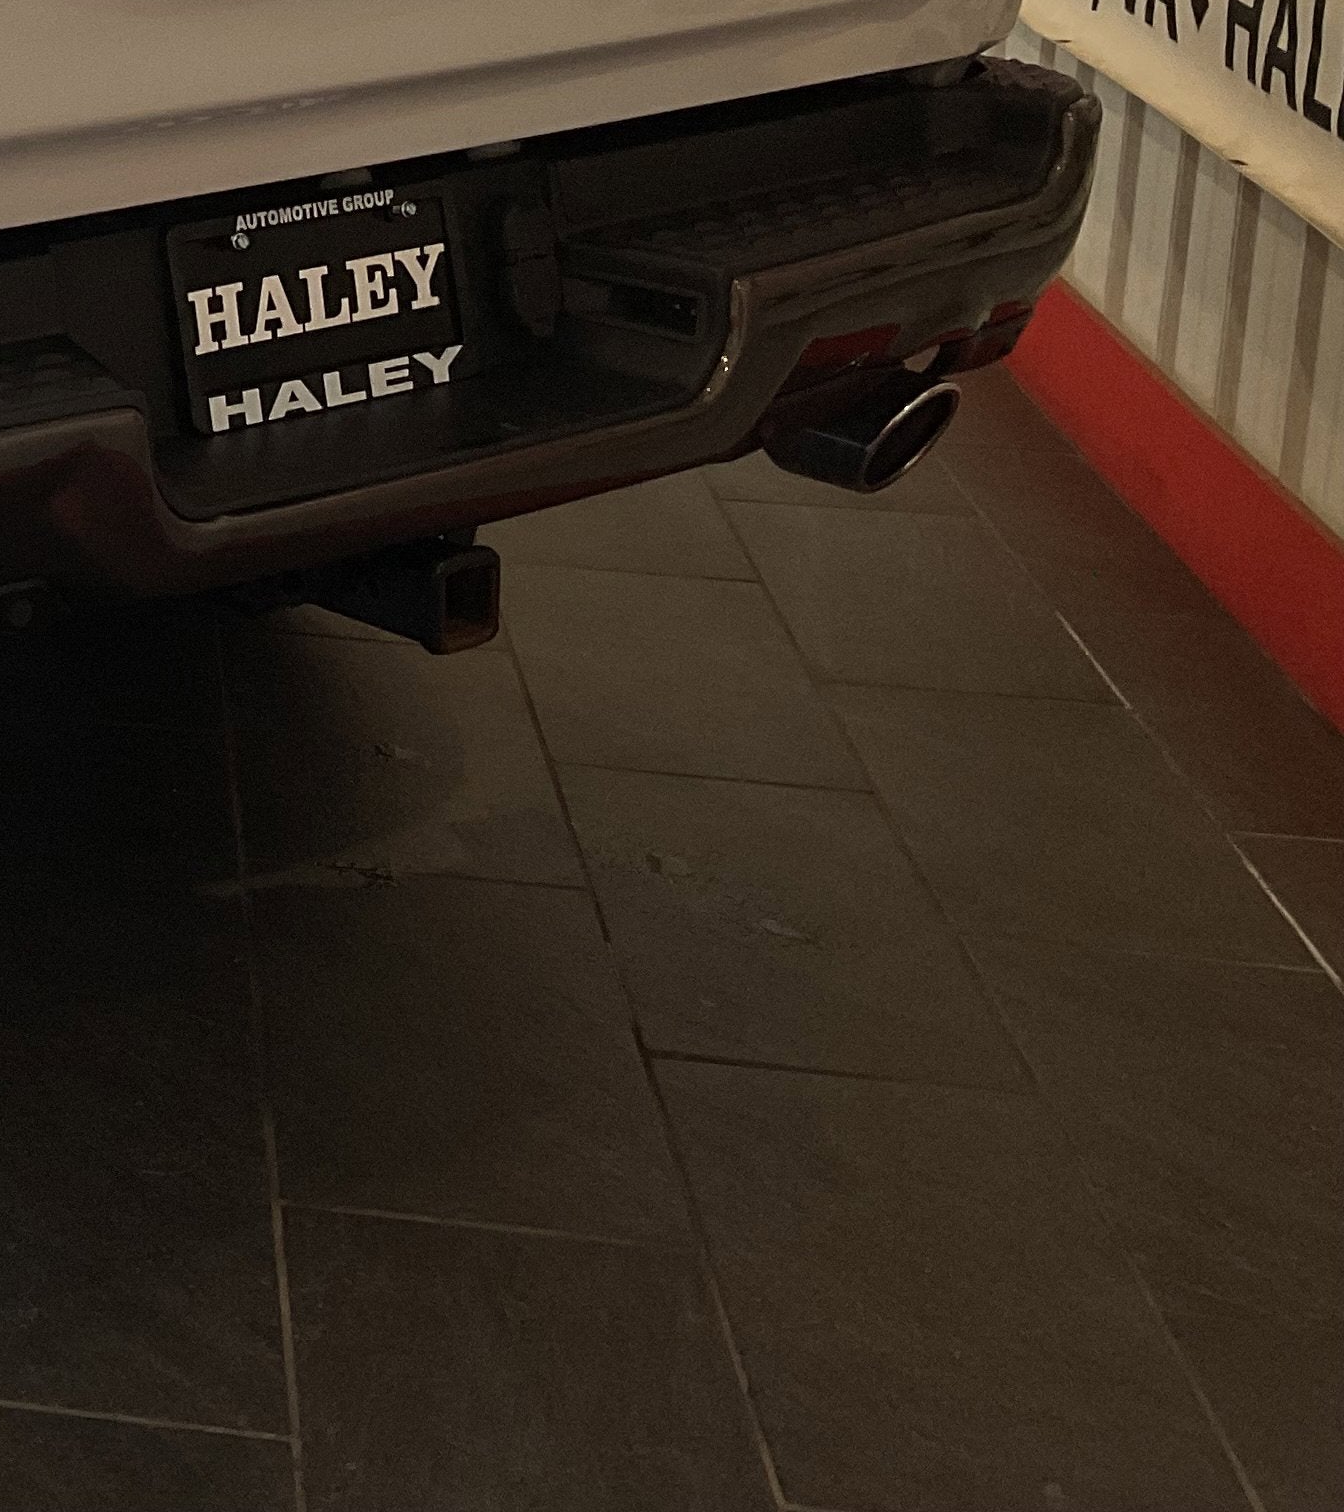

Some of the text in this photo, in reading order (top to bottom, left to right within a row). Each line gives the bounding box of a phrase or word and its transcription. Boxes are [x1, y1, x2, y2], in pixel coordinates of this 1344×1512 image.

[236, 189, 394, 231] AUTOMOTIVE GROUP
[187, 242, 445, 356] HALEY
[208, 345, 463, 432] HALEY
